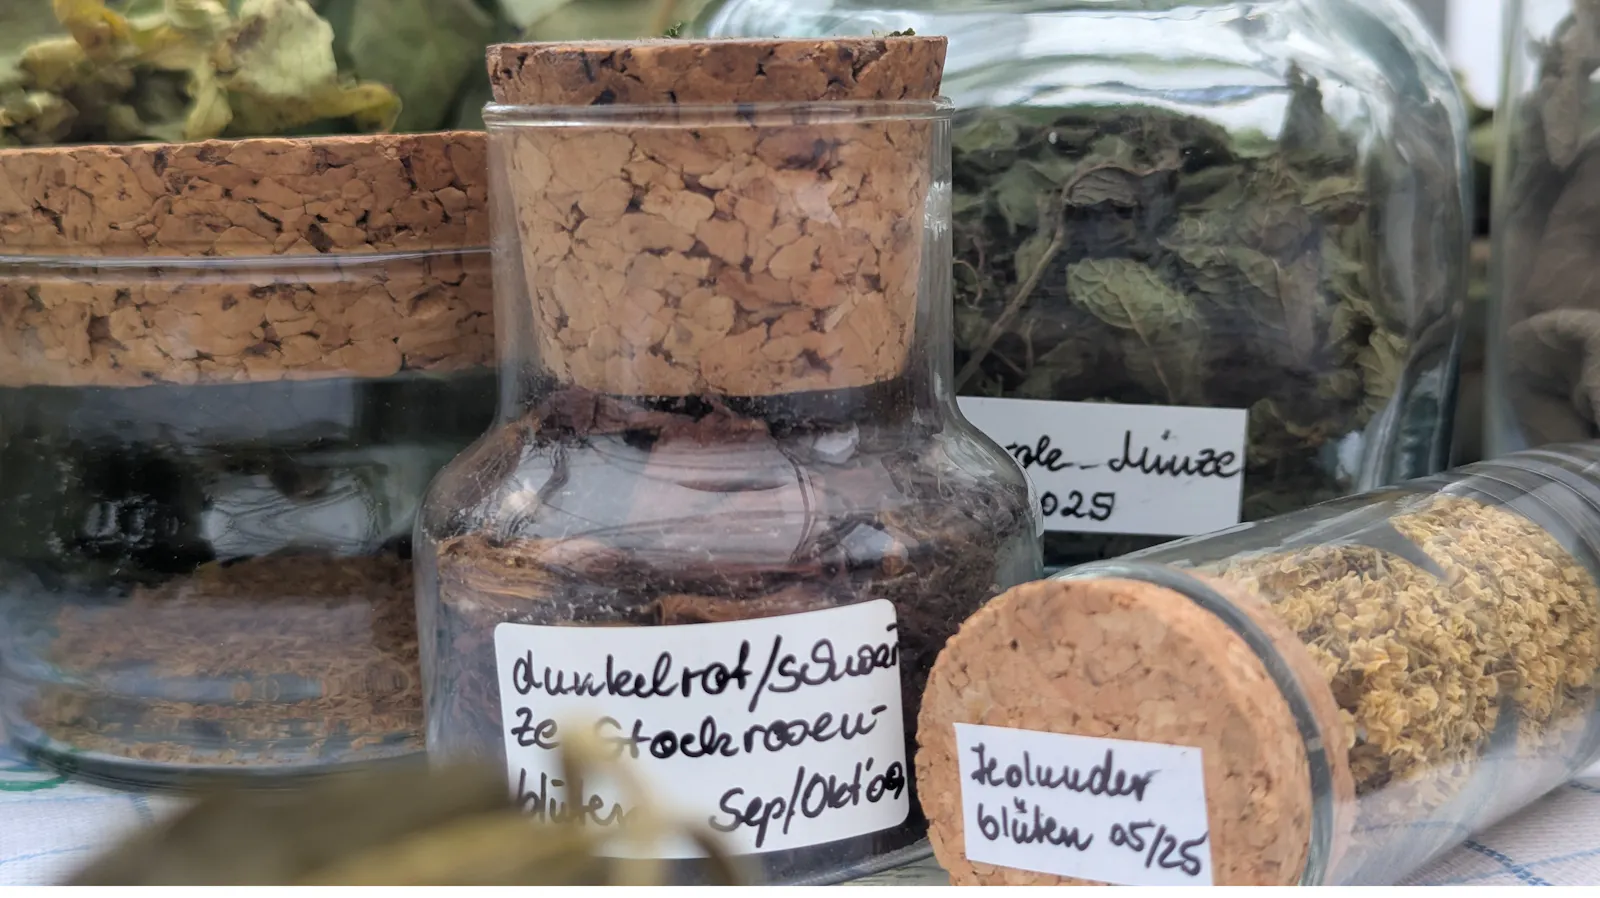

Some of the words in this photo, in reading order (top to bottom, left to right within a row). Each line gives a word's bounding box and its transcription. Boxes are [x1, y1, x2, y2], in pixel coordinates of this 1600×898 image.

[1040, 489, 1115, 522] 025
[970, 742, 1162, 801] Holunder
[1109, 818, 1209, 876] 05/25
